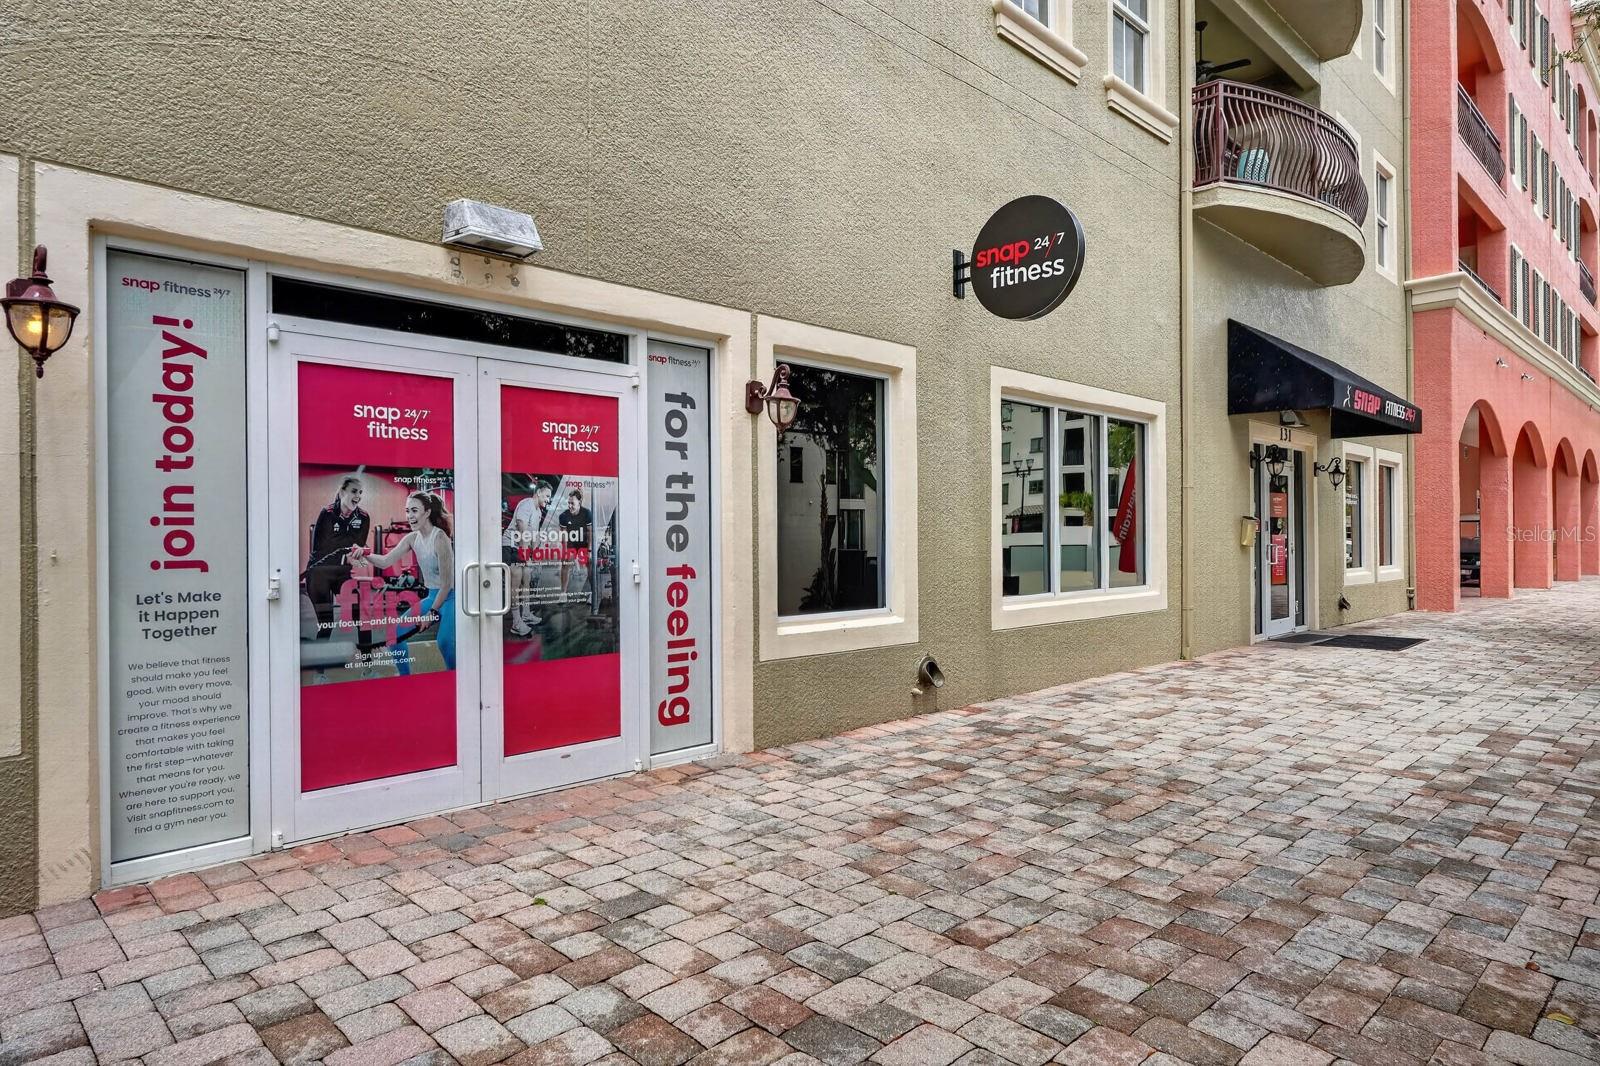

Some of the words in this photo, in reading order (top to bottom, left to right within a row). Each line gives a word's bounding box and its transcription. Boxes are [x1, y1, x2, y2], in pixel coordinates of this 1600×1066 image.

[976, 240, 1030, 268] snap
[1034, 232, 1065, 258] 24/7
[990, 258, 1065, 289] fitness
[122, 277, 160, 292] snap
[163, 281, 211, 298] fitness
[213, 287, 231, 300] 24/7
[648, 354, 668, 365] snap
[668, 356, 692, 367] fitness
[152, 315, 207, 473] today!
[353, 404, 400, 424] snap
[404, 409, 429, 426] 24/7
[1385, 400, 1405, 420] FITNESS
[367, 421, 429, 441] fitness
[541, 421, 578, 438] snap
[580, 425, 599, 439] 24/7
[664, 391, 696, 460] for
[1279, 427, 1292, 442] 131
[552, 436, 599, 453] fitness
[394, 476, 412, 485] snap
[413, 475, 437, 484] fitness
[565, 480, 583, 489] snap
[583, 480, 606, 489] fitness
[665, 472, 696, 553] the
[150, 485, 209, 573] join
[510, 527, 584, 548] personal
[517, 543, 590, 567] training
[136, 592, 173, 606] Let's
[177, 590, 222, 603] Make
[138, 610, 150, 622] it
[154, 609, 219, 624] Happen
[317, 621, 339, 630] your
[387, 616, 403, 625] feel
[403, 613, 440, 623] fantastic
[142, 625, 217, 642] Together
[355, 652, 372, 661] Sign
[373, 651, 384, 660] up
[384, 649, 406, 658] today
[657, 564, 698, 727] feeling
[128, 663, 143, 671] We
[146, 660, 179, 669] believe
[182, 658, 200, 666] that
[202, 656, 231, 664] fitness
[354, 656, 416, 669] snapfitness.com
[131, 674, 163, 683] should
[166, 671, 191, 680] make
[194, 670, 210, 679] you
[127, 687, 154, 698] good.
[156, 684, 176, 693] With
[179, 682, 203, 691] every
[139, 700, 159, 709] your
[162, 695, 189, 704] mood
[192, 692, 222, 702] should
[127, 711, 168, 722] improve.
[172, 707, 197, 716] That's
[200, 704, 217, 713] why
[118, 726, 149, 736] create
[161, 721, 190, 729] fitness
[193, 714, 240, 726] experience
[136, 737, 155, 746] that
[158, 733, 188, 743] makes
[191, 731, 207, 739] you
[126, 746, 184, 760] comfortable
[187, 743, 205, 751] with
[207, 739, 234, 748] taking
[127, 764, 142, 772] the
[145, 761, 162, 769] first
[165, 750, 233, 767] step—whatever
[137, 775, 156, 784] that
[159, 770, 190, 780] means
[193, 767, 204, 775] for
[207, 764, 225, 774] you.
[119, 786, 167, 799] Whenever
[170, 780, 196, 793] you're
[199, 776, 226, 786] ready,
[145, 799, 166, 808] here
[180, 789, 214, 803] support
[217, 787, 235, 797] you.
[127, 814, 146, 823] Visit
[149, 801, 223, 820] snapfitness.com
[135, 826, 152, 835] find
[164, 820, 185, 831] gym
[187, 815, 207, 824] near
[210, 813, 228, 822] you.
